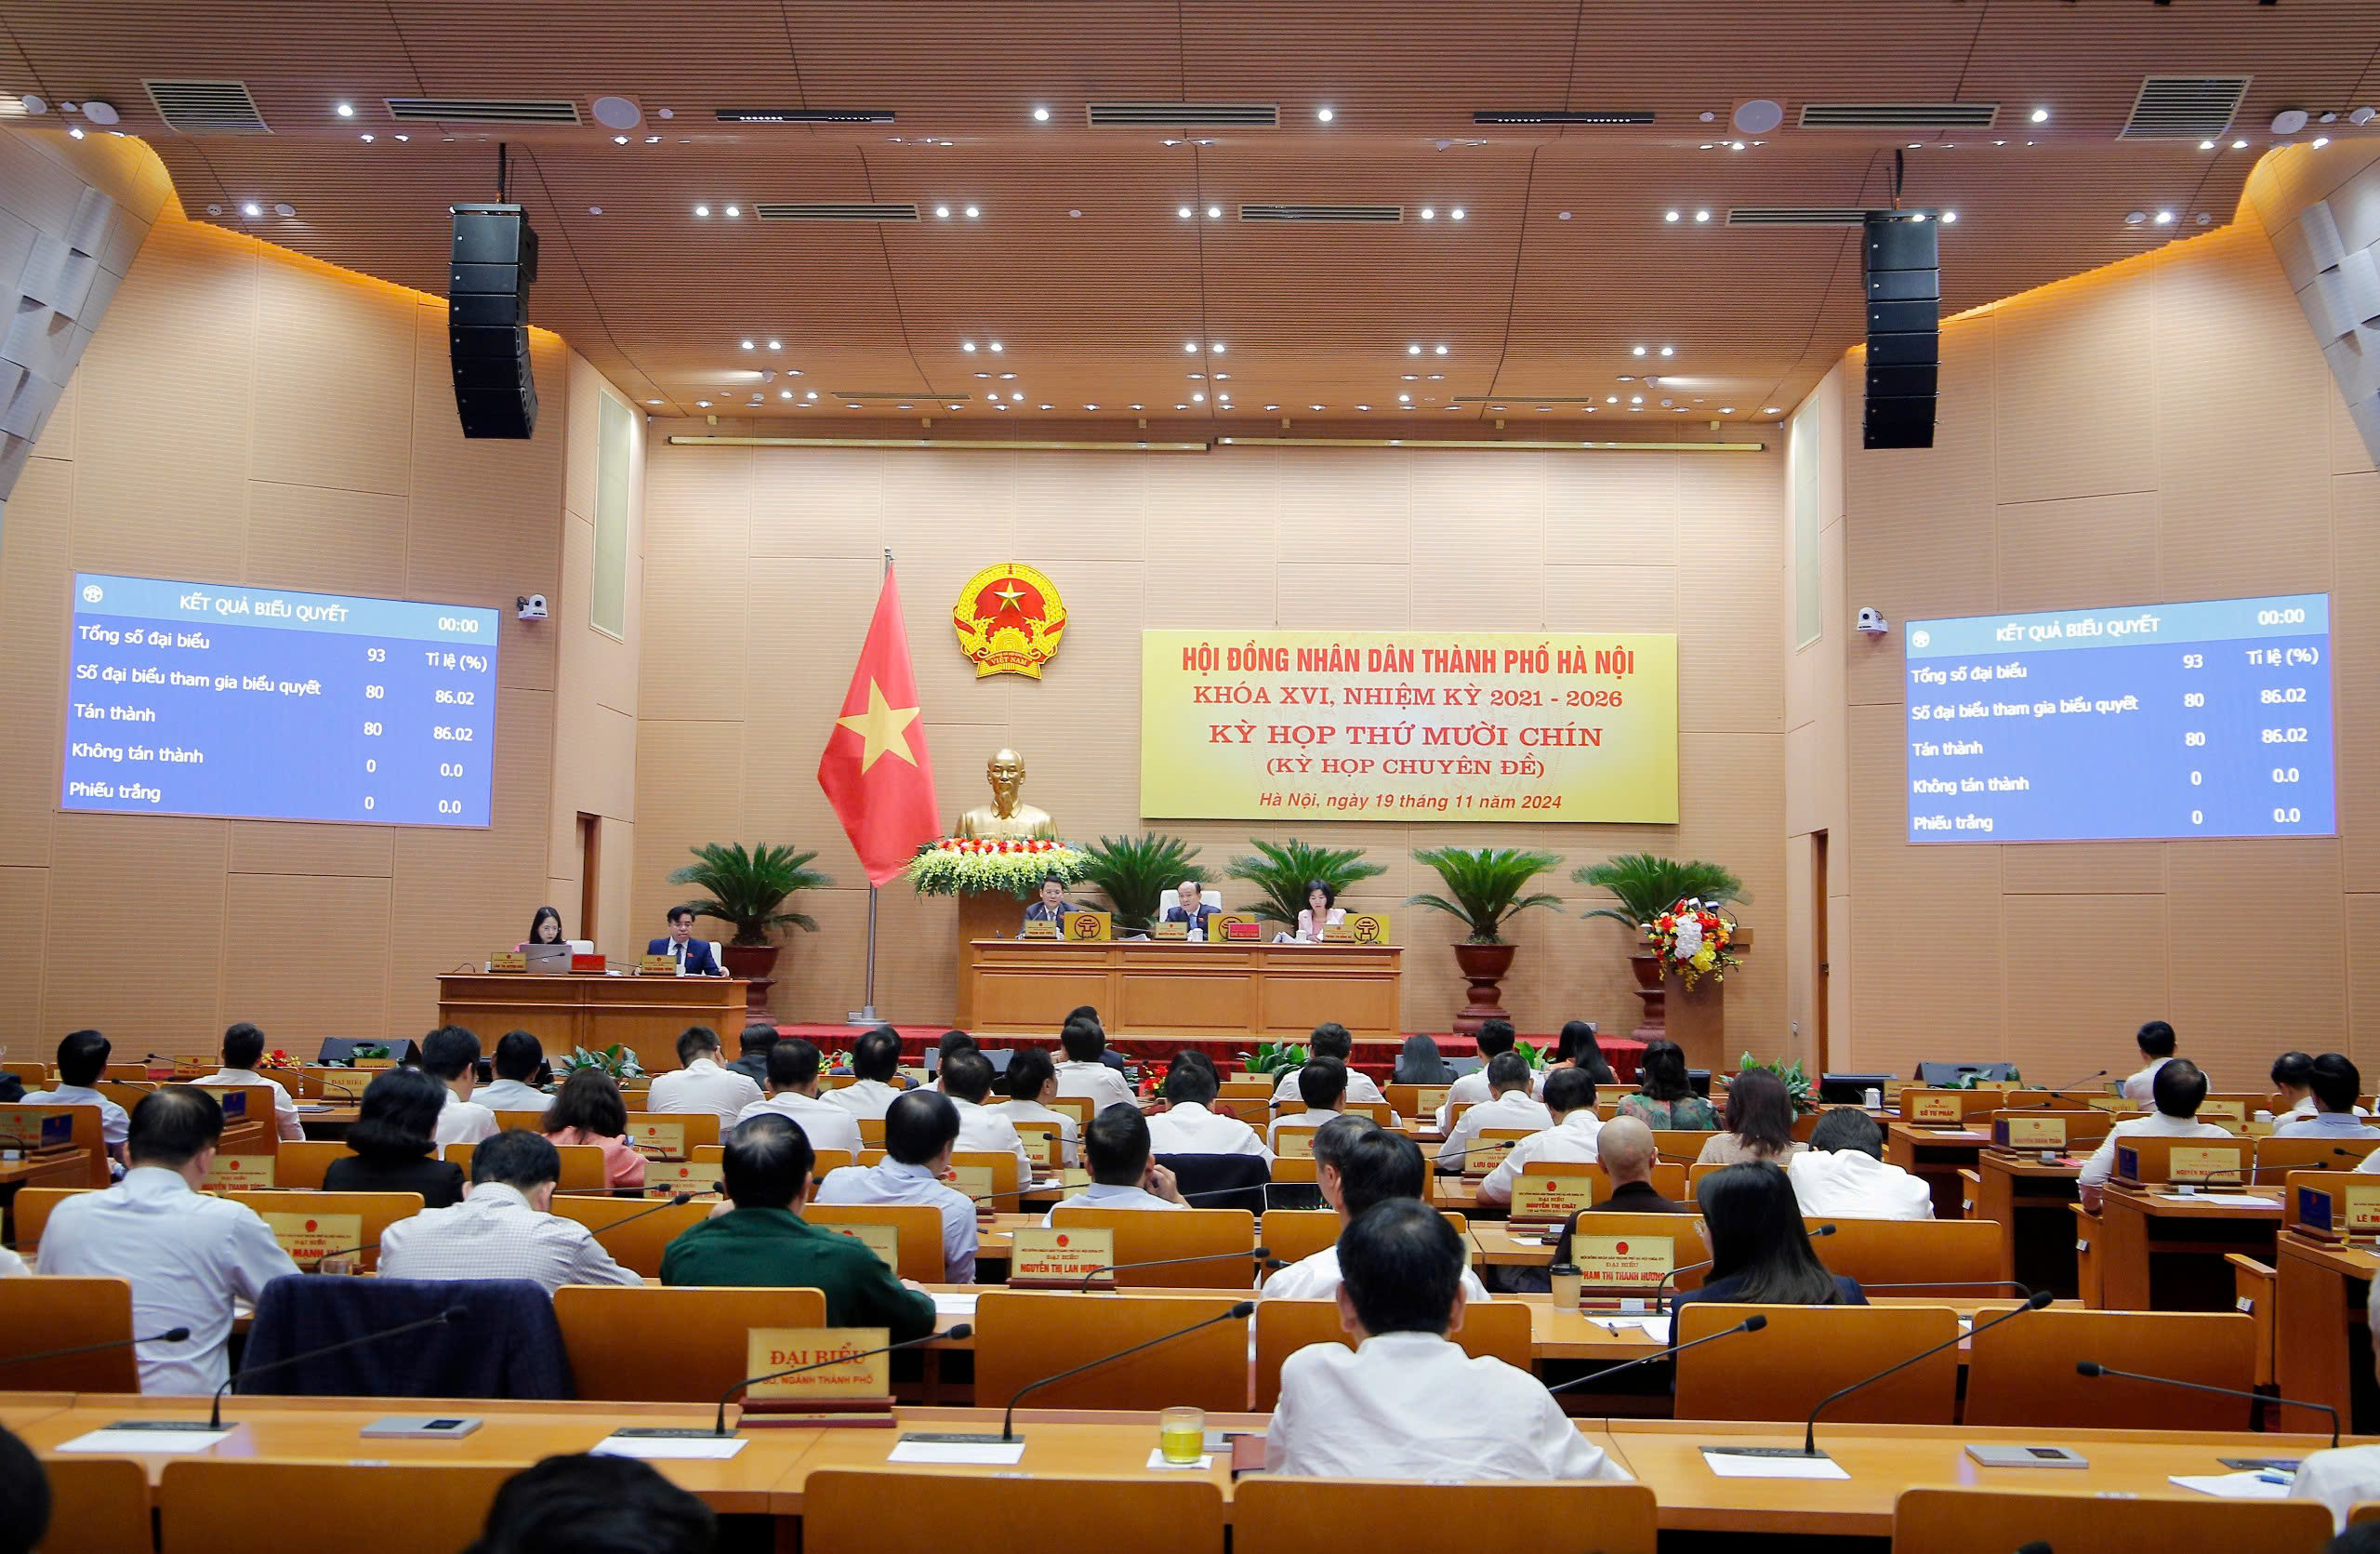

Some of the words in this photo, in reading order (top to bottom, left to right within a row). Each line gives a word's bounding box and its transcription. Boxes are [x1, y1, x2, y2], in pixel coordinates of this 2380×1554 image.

[180, 592, 211, 610] KẾT
[216, 597, 249, 615] QUẢ
[255, 600, 291, 618] BIỂU
[297, 604, 349, 621] QUYẾT
[2258, 608, 2305, 625] 00:00
[439, 618, 478, 632] 00:00
[1997, 623, 2025, 641] KẾT
[2029, 620, 2062, 642] QUẢ
[2067, 619, 2103, 637] BIỂU
[2107, 615, 2161, 637] QUYẾT
[79, 625, 119, 644] Tổng
[125, 629, 143, 644] số
[148, 631, 171, 648] đại
[178, 632, 209, 648] biểu
[368, 648, 385, 662] 93
[426, 652, 439, 666] Tỉ
[443, 654, 456, 670] lệ
[460, 656, 487, 672] (%)
[1183, 643, 1219, 676] HỘI
[1227, 640, 1289, 671] ĐỒNG
[1297, 644, 1360, 672] NHÂN
[1368, 644, 1414, 672] DÂN
[1421, 644, 1496, 673] THÀNH
[1504, 642, 1549, 674] PHỐ
[1557, 645, 1587, 674] HÀ
[1595, 645, 1633, 679] NỘI
[2184, 655, 2202, 668] 93
[2246, 650, 2262, 664] Tỉ
[2268, 649, 2281, 666] lệ
[2287, 647, 2318, 665] (%)
[77, 665, 98, 679] Số
[102, 667, 126, 684] đại
[132, 668, 165, 684] biểu
[170, 671, 209, 686] tham
[215, 675, 237, 691] gia
[244, 675, 274, 691] biểu
[280, 680, 321, 696] quyết
[1911, 667, 1946, 684] Tổng
[1950, 667, 1967, 681] số
[1971, 667, 1992, 682] đại
[1997, 662, 2027, 678] biểu
[366, 685, 384, 698] 80
[436, 690, 474, 705] 86.02
[1195, 682, 1271, 704] KHÓA
[1281, 686, 1335, 705] XVI,
[1344, 683, 1435, 710] NHIỆM
[1444, 684, 1480, 706] KỲ
[1490, 690, 1542, 707] 2021
[1567, 690, 1621, 707] 2026
[2261, 688, 2306, 703] 86.02
[2185, 693, 2204, 707] 80
[74, 703, 104, 718] Tán
[111, 706, 155, 722] thành
[1912, 705, 1930, 720] Số
[1934, 706, 1954, 721] đại
[1960, 701, 1989, 717] biểu
[1993, 702, 2030, 716] tham
[2034, 701, 2056, 717] gia
[2060, 697, 2091, 712] biểu
[2096, 696, 2138, 714] quyết
[364, 723, 382, 736] 80
[434, 726, 472, 740] 86.02
[1210, 720, 1257, 744] KỲ
[1269, 725, 1336, 750] HỌP
[1346, 722, 1416, 746] THỨ
[1423, 722, 1508, 747] MƯỜI
[1519, 722, 1602, 747] CHÍN
[2263, 728, 2307, 743] 86.02
[2186, 732, 2205, 746] 80
[73, 743, 123, 762] Không
[128, 746, 153, 760] tán
[159, 748, 203, 763] thành
[1912, 742, 1938, 756] Tán
[1943, 741, 1983, 755] thành
[367, 760, 376, 772] 0
[441, 764, 462, 777] 0.0
[1267, 755, 1312, 774] (KỲ
[1322, 759, 1375, 775] HỌP
[1383, 755, 1491, 774] CHUYÊN
[1501, 752, 1544, 778] ĐỀ)
[2191, 772, 2202, 785] 0
[2273, 768, 2298, 782] 0.0
[70, 782, 113, 797] Phiếu
[119, 783, 160, 803] trắng
[1914, 778, 1957, 795] Không
[1962, 777, 1984, 791] tán
[1988, 777, 2029, 790] thành
[365, 797, 374, 809] 0
[439, 800, 461, 813] 0.0
[1261, 793, 1282, 806] Hà
[1289, 793, 1318, 808] Nội,
[1327, 794, 1368, 810] ngày
[1377, 794, 1394, 807] 19
[1400, 796, 1448, 811] tháng
[1458, 796, 1472, 807] 11
[1480, 796, 1515, 808] năm
[1521, 795, 1562, 809] 2024
[1914, 816, 1951, 830] Phiếu
[1956, 814, 1993, 831] trắng
[2192, 811, 2202, 824] 0
[2275, 808, 2300, 822] 0.0
[1064, 1264, 1078, 1273] LAN
[1581, 1270, 1600, 1282] HẠM
[1616, 1271, 1639, 1281] THANH
[770, 1349, 808, 1369] ĐẠI
